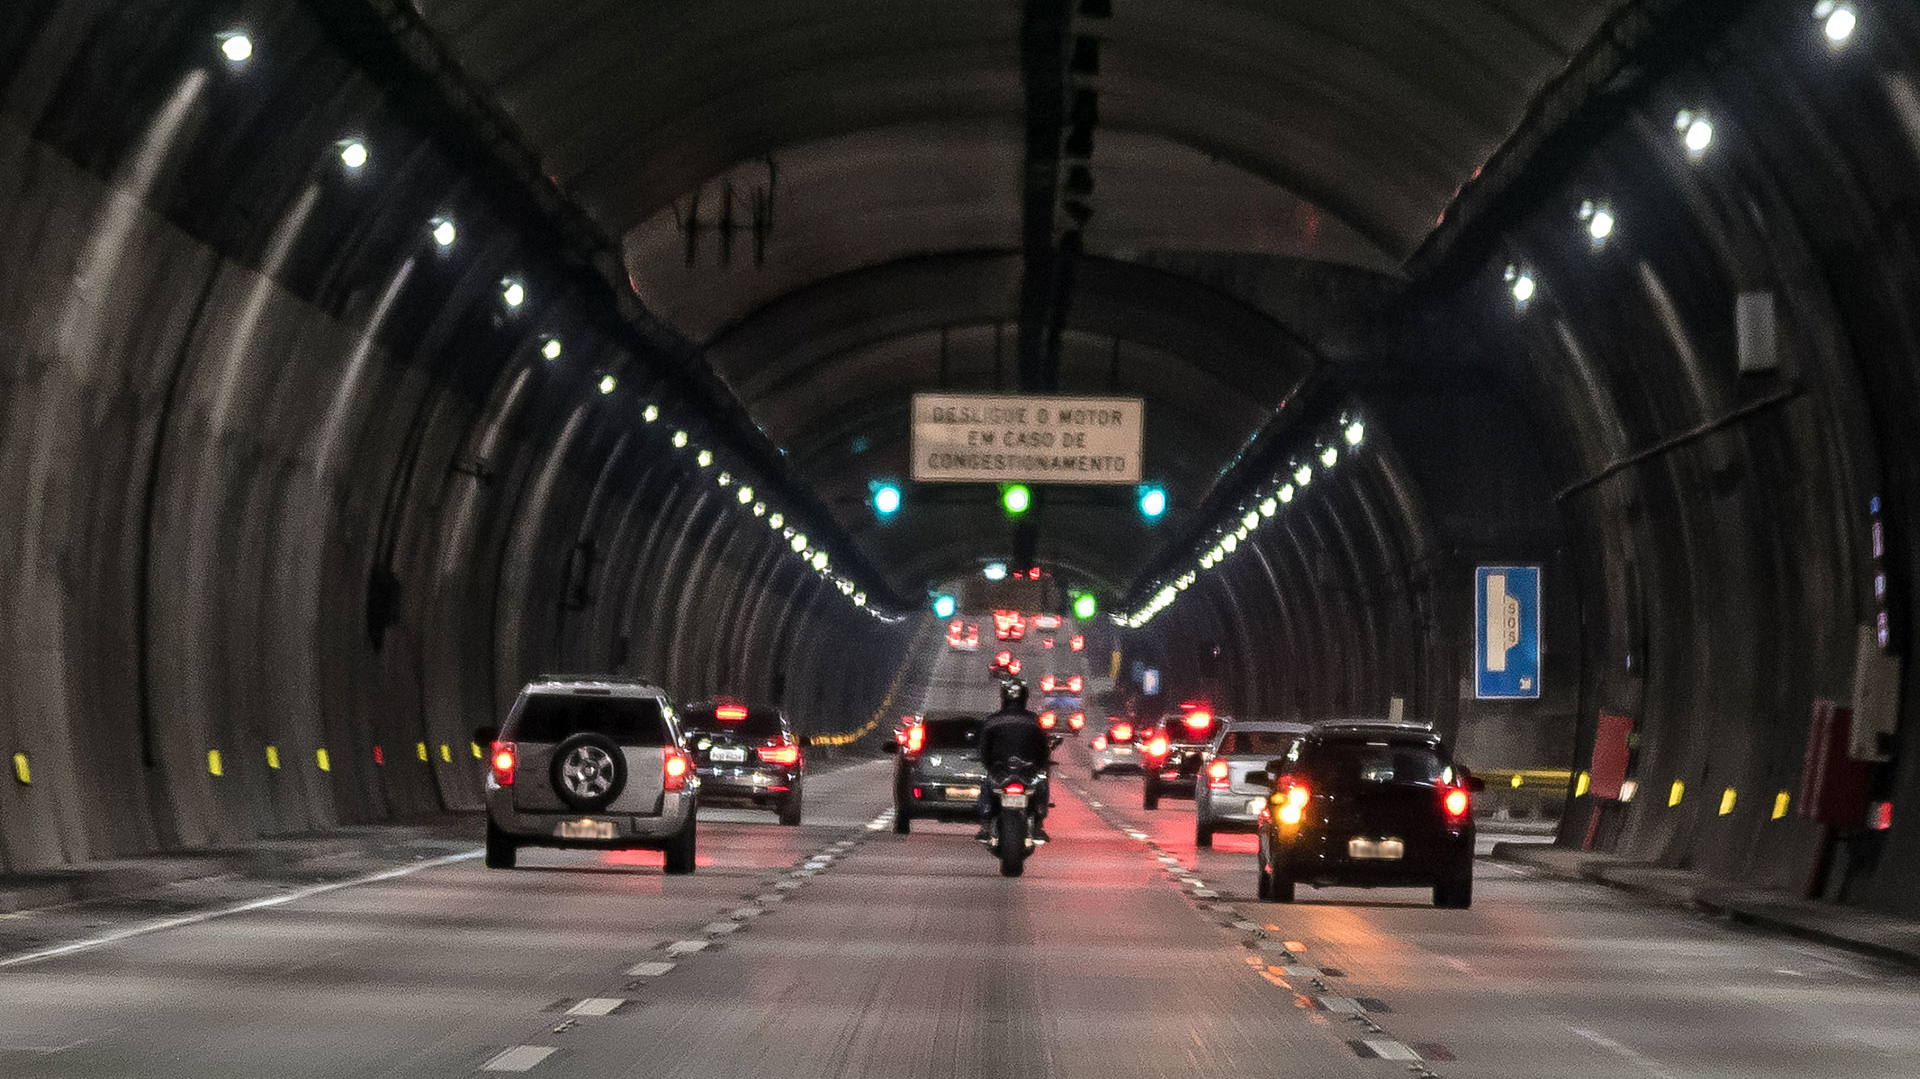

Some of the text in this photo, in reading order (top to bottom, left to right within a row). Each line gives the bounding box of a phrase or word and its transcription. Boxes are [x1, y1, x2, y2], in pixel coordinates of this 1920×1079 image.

[932, 406, 1122, 425] DESLIGUE O MOTOR
[967, 430, 1086, 448] EM CASO DE
[928, 452, 1126, 472] CONGESTIONAMENTO
[1507, 603, 1516, 643] SOS
